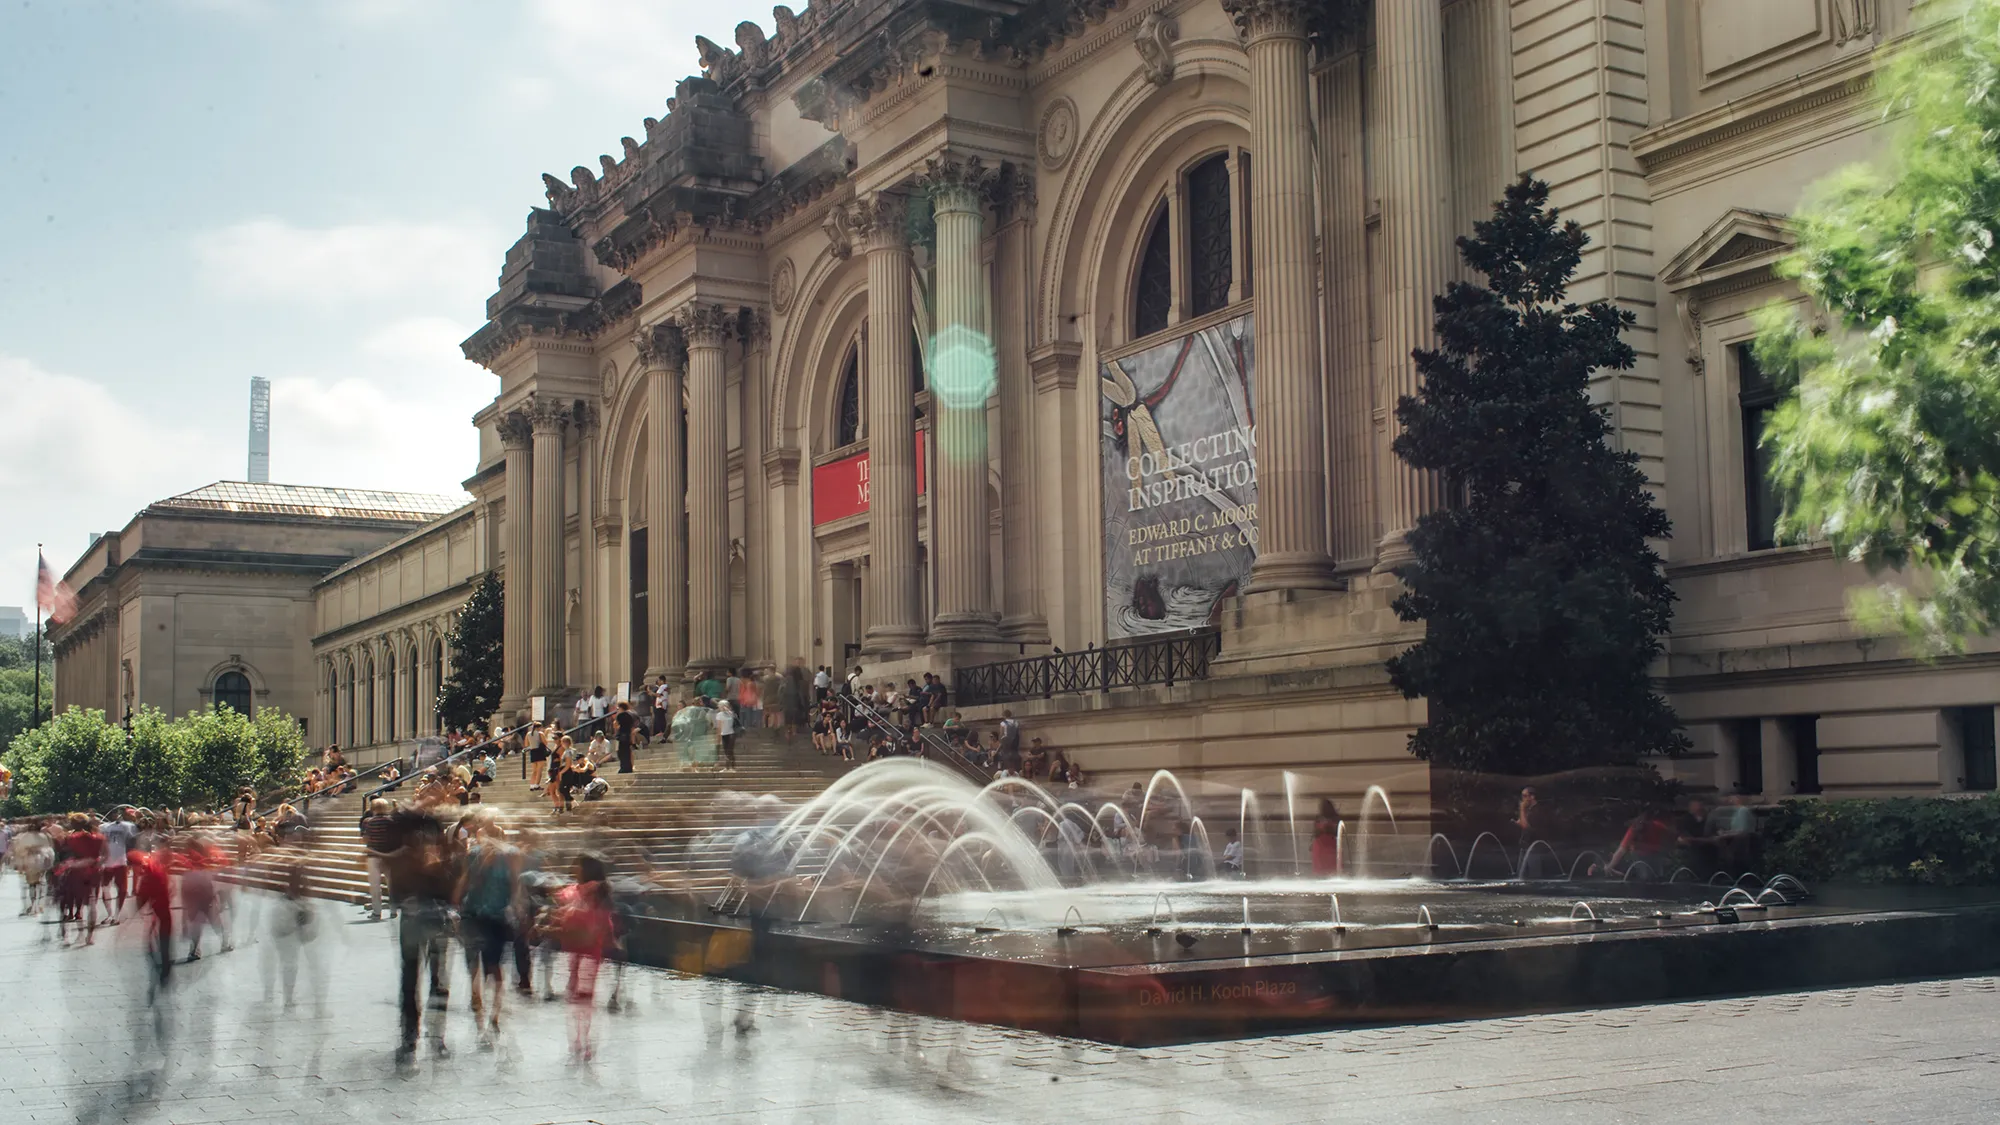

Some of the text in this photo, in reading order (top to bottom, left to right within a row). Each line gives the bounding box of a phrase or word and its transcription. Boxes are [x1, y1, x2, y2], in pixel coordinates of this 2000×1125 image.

[857, 481, 871, 505] ME
[1128, 503, 1259, 546] EDWARD C. MOOR
[1133, 548, 1152, 567] AT
[1155, 534, 1219, 562] TIFFANY
[1221, 532, 1235, 550] &
[1140, 980, 1297, 1006] David H. Koch Plaza
